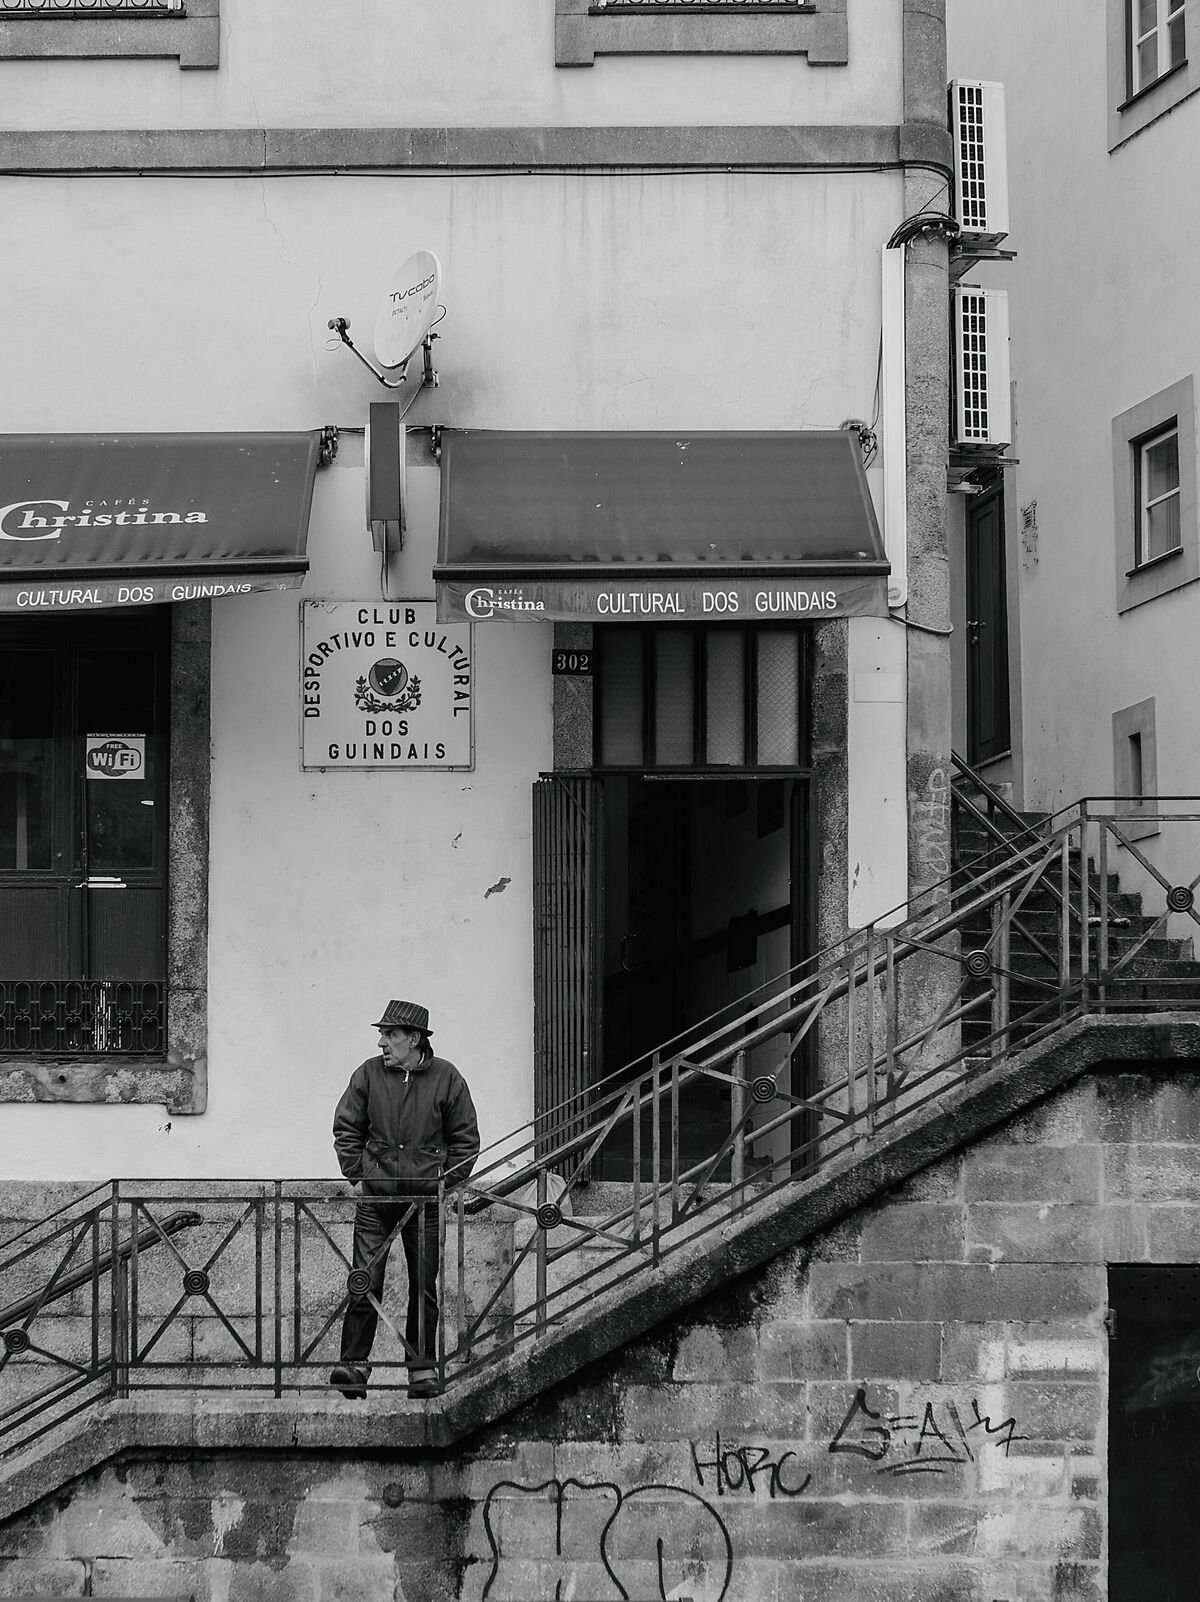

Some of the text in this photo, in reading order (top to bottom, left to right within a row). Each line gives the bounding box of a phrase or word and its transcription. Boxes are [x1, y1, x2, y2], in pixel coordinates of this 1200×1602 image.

[85, 497, 150, 507] CAFÉS
[16, 583, 252, 607] CULTURAL DOS GUINDAIS
[464, 587, 546, 618] Christina
[597, 590, 837, 614] CULTURAL DOS GUINDAIS
[358, 608, 416, 625] CLUB
[557, 653, 589, 671] 302
[304, 631, 470, 718] DESPORTIVO E CULTURAL
[365, 720, 409, 737] DOS
[328, 743, 446, 760] GUINDAIS
